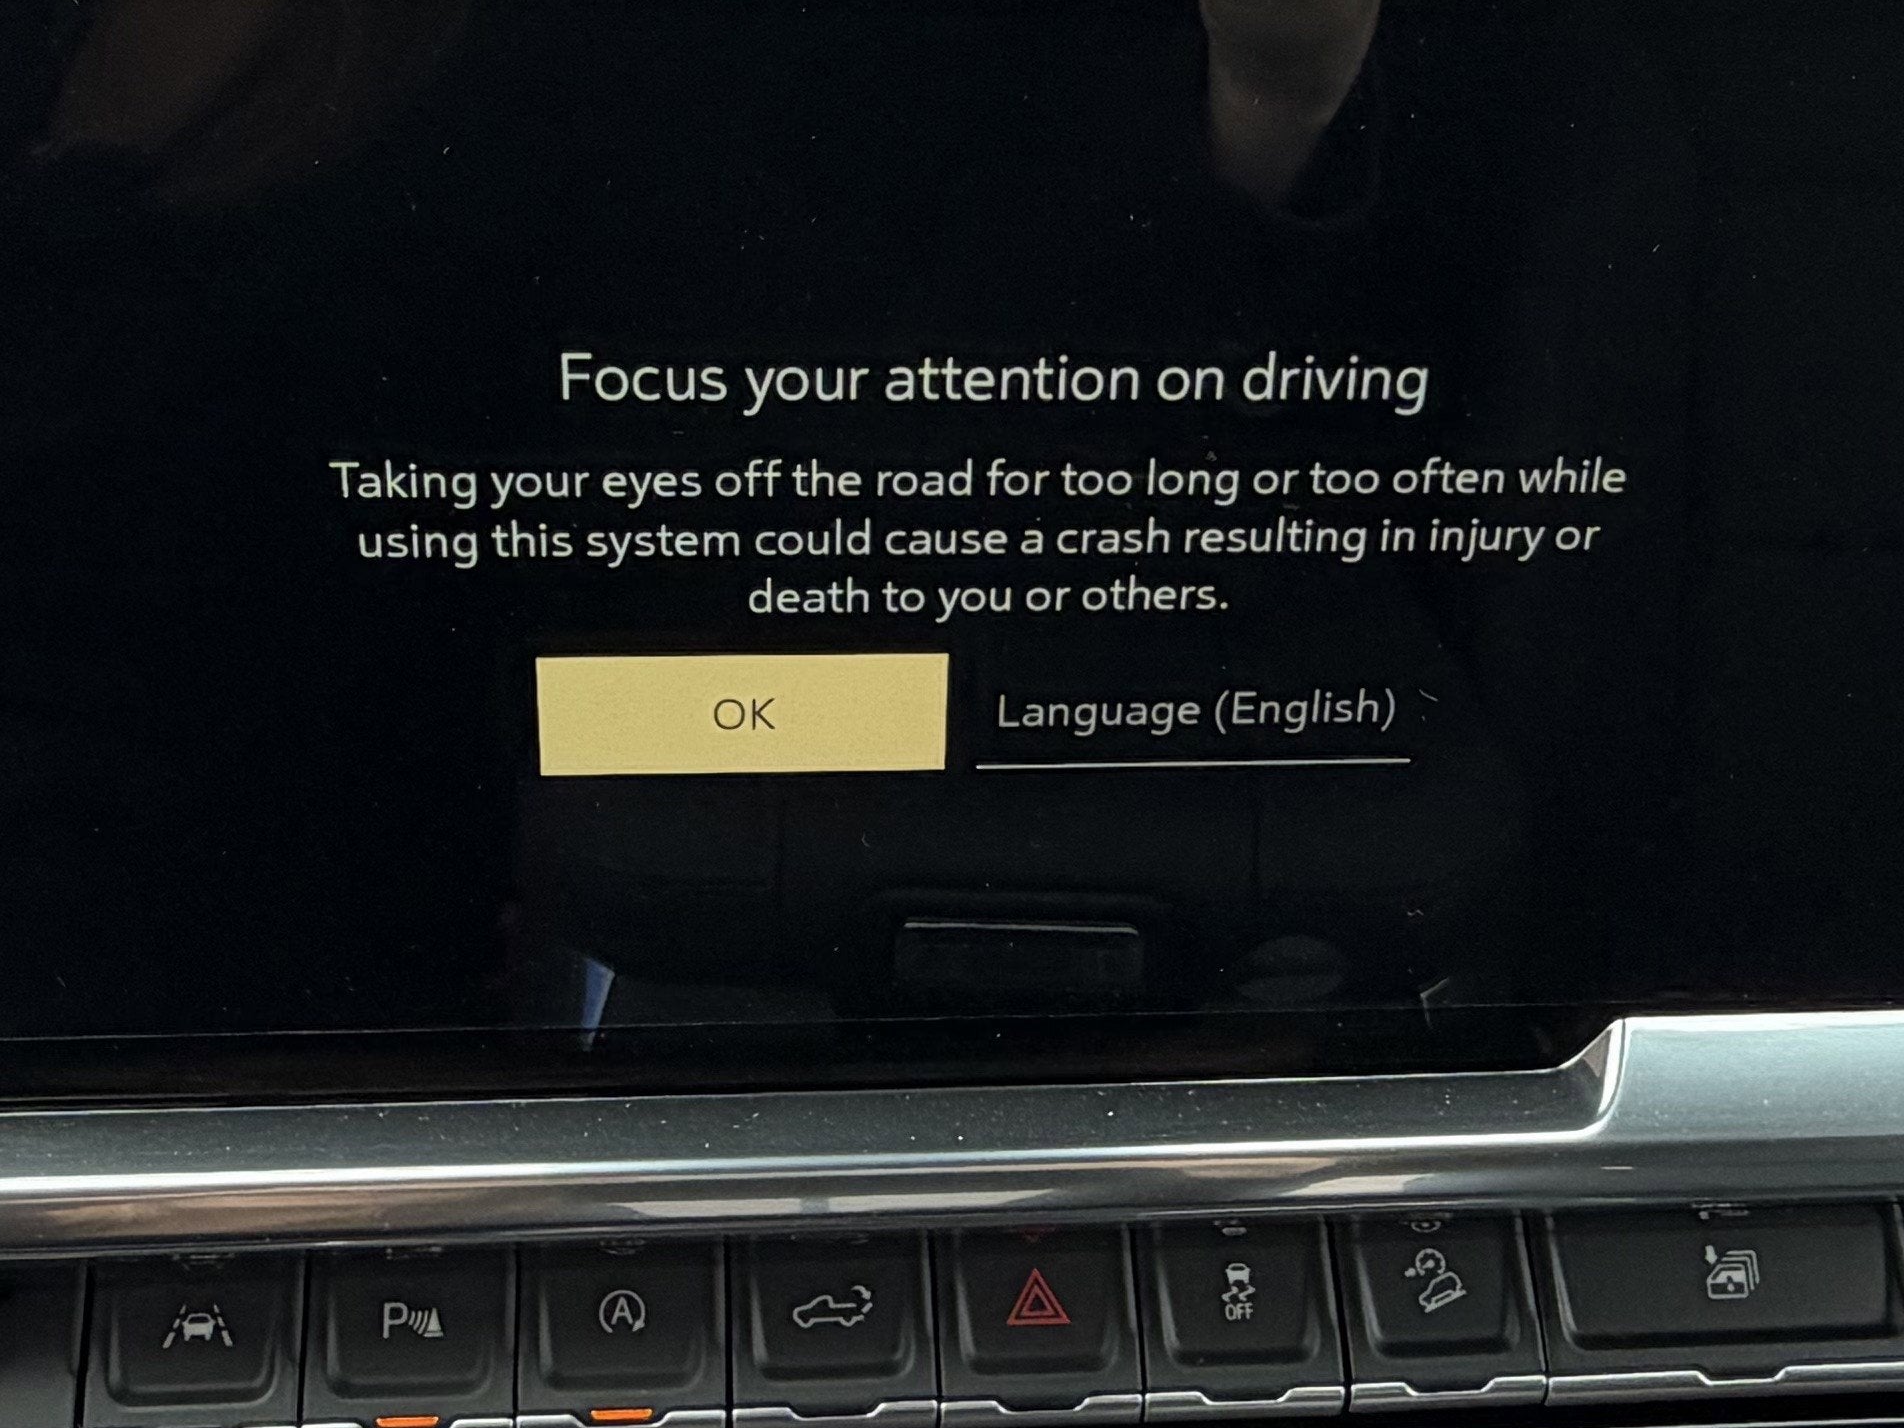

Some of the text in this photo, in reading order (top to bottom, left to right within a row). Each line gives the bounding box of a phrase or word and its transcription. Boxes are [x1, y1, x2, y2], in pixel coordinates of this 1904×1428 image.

[560, 350, 1428, 417] Focus your attention on driving
[328, 455, 1626, 510] Taking your eyes off the road for too long or too often while
[358, 515, 1601, 569] using this system could cause a crash resulting in injury or
[748, 574, 1228, 624] death to you or others.
[713, 697, 776, 731] OK
[998, 688, 1395, 736] Language (English)
[1224, 1302, 1254, 1321] OFF
